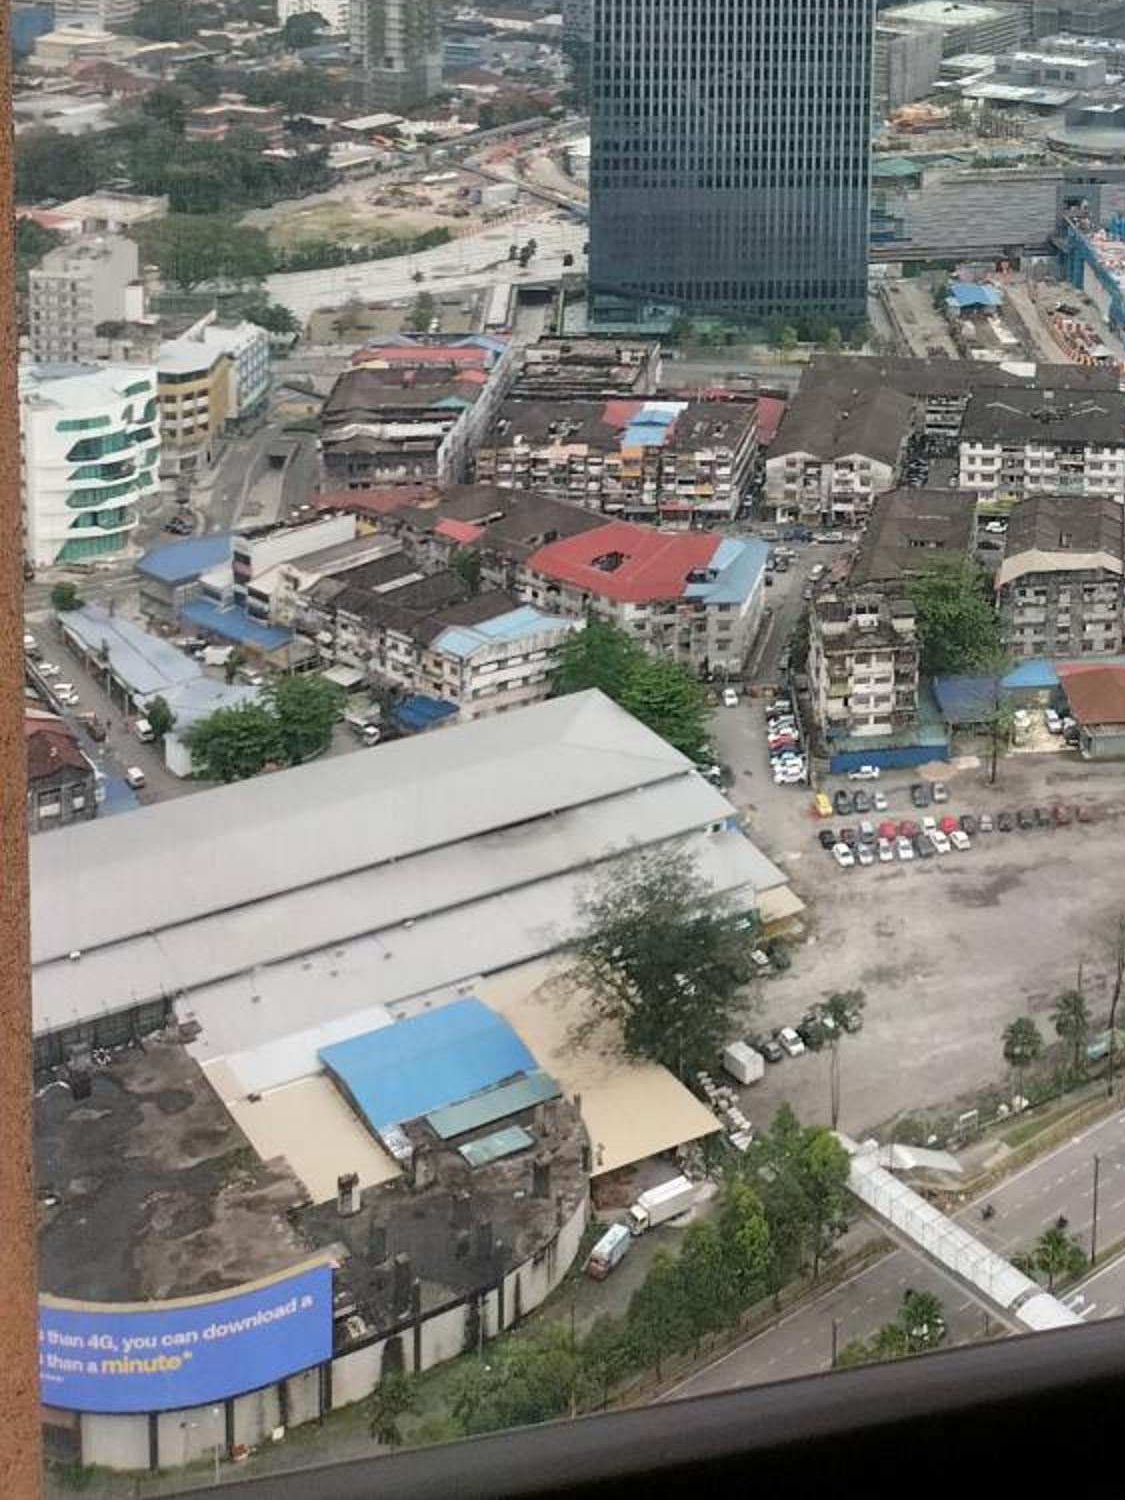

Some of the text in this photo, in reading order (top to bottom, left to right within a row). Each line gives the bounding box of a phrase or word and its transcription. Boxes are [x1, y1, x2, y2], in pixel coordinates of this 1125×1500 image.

[47, 1330, 84, 1348] than
[87, 1334, 118, 1351] 4G,
[122, 1335, 157, 1353] you
[161, 1330, 198, 1346] can
[202, 1297, 297, 1340] download
[300, 1294, 313, 1308] a
[46, 1352, 83, 1372] than
[86, 1361, 98, 1374] a
